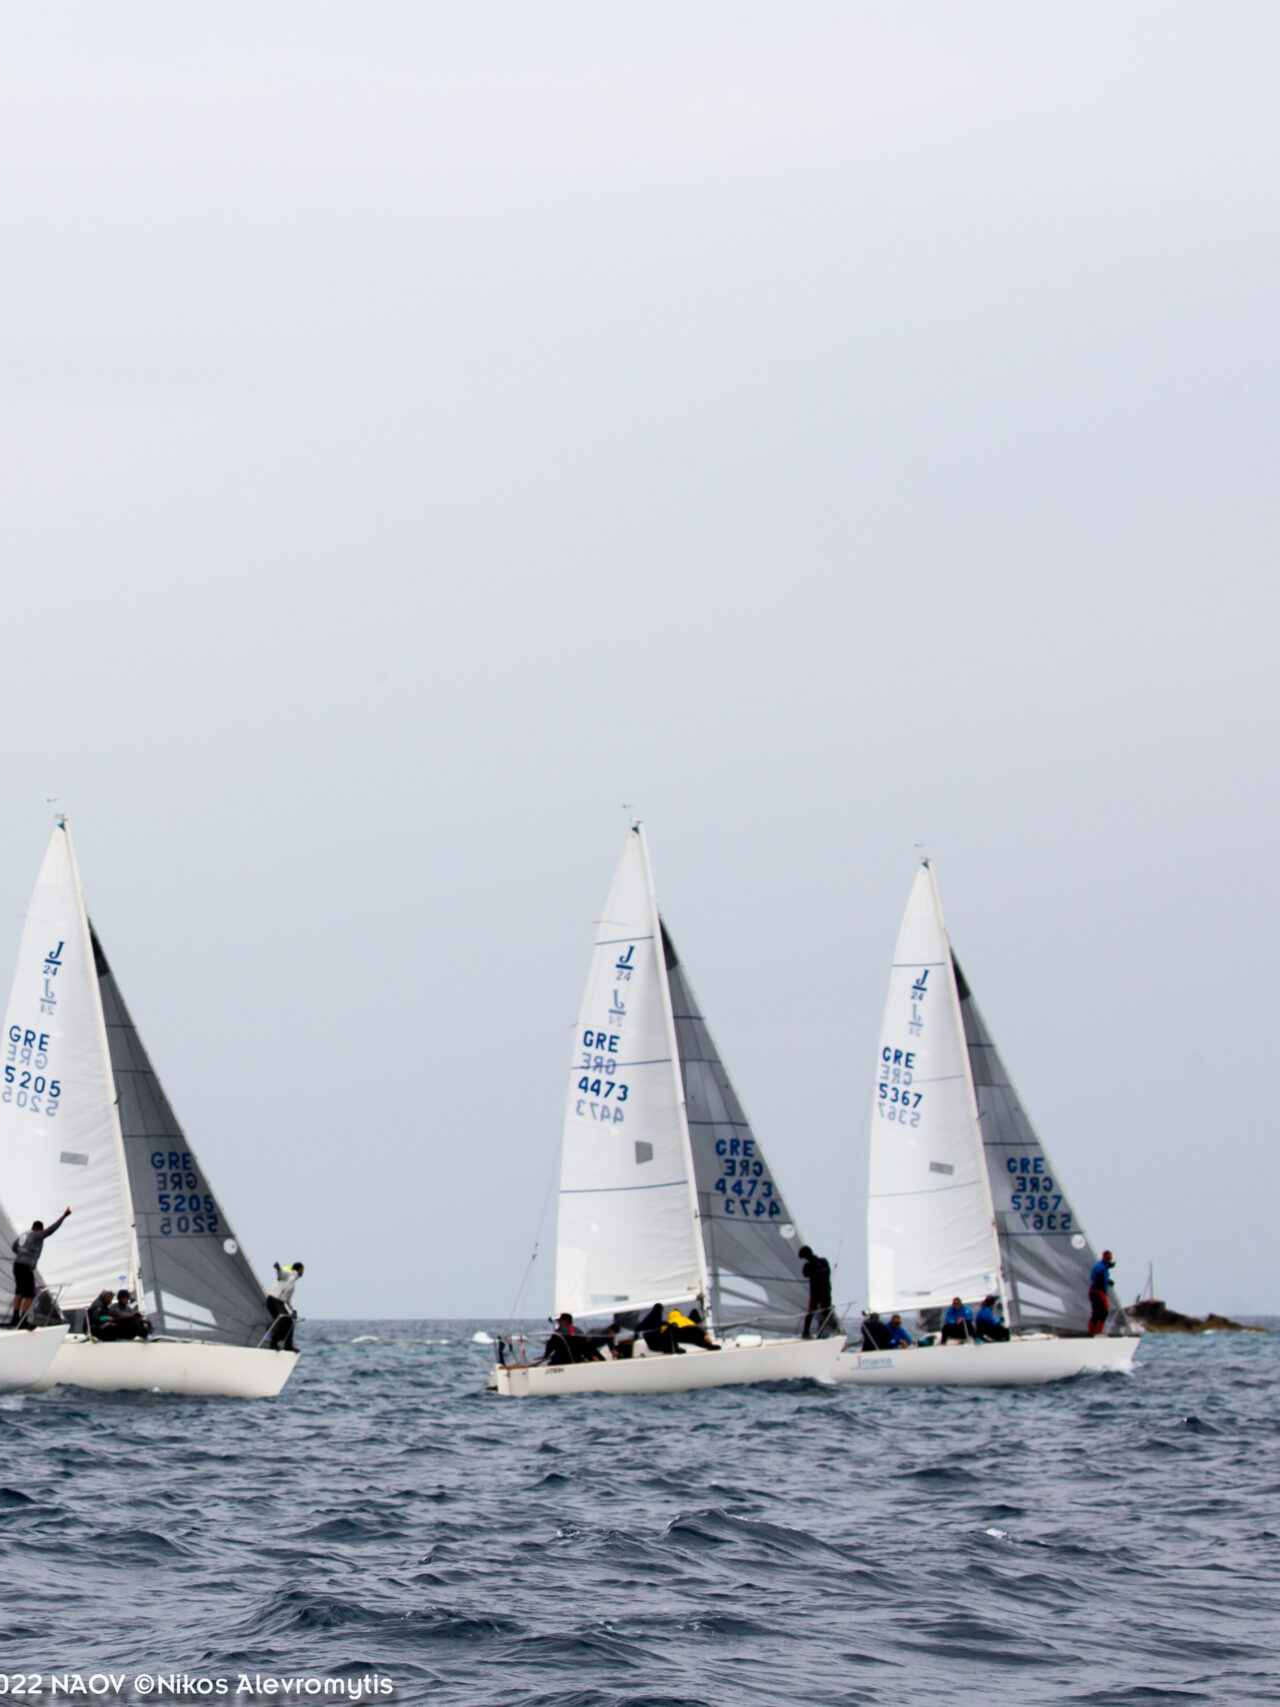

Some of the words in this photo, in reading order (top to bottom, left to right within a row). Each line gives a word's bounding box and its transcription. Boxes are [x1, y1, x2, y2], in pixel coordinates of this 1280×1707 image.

[49, 941, 65, 959] J
[619, 946, 635, 964] J
[42, 965, 58, 976] 24
[616, 970, 632, 982] 24
[9, 1025, 50, 1052] GRE
[583, 1030, 620, 1053] GRE
[882, 1046, 916, 1069] GRE
[4, 1065, 61, 1098] 5205
[578, 1076, 628, 1102] 4473
[879, 1083, 923, 1108] 5367
[715, 1138, 755, 1158] GRE
[151, 1152, 192, 1171] GRE
[1006, 1157, 1045, 1174] GRE
[715, 1178, 772, 1198] 4473
[158, 1194, 214, 1213] 5205
[1010, 1194, 1062, 1211] 5367
